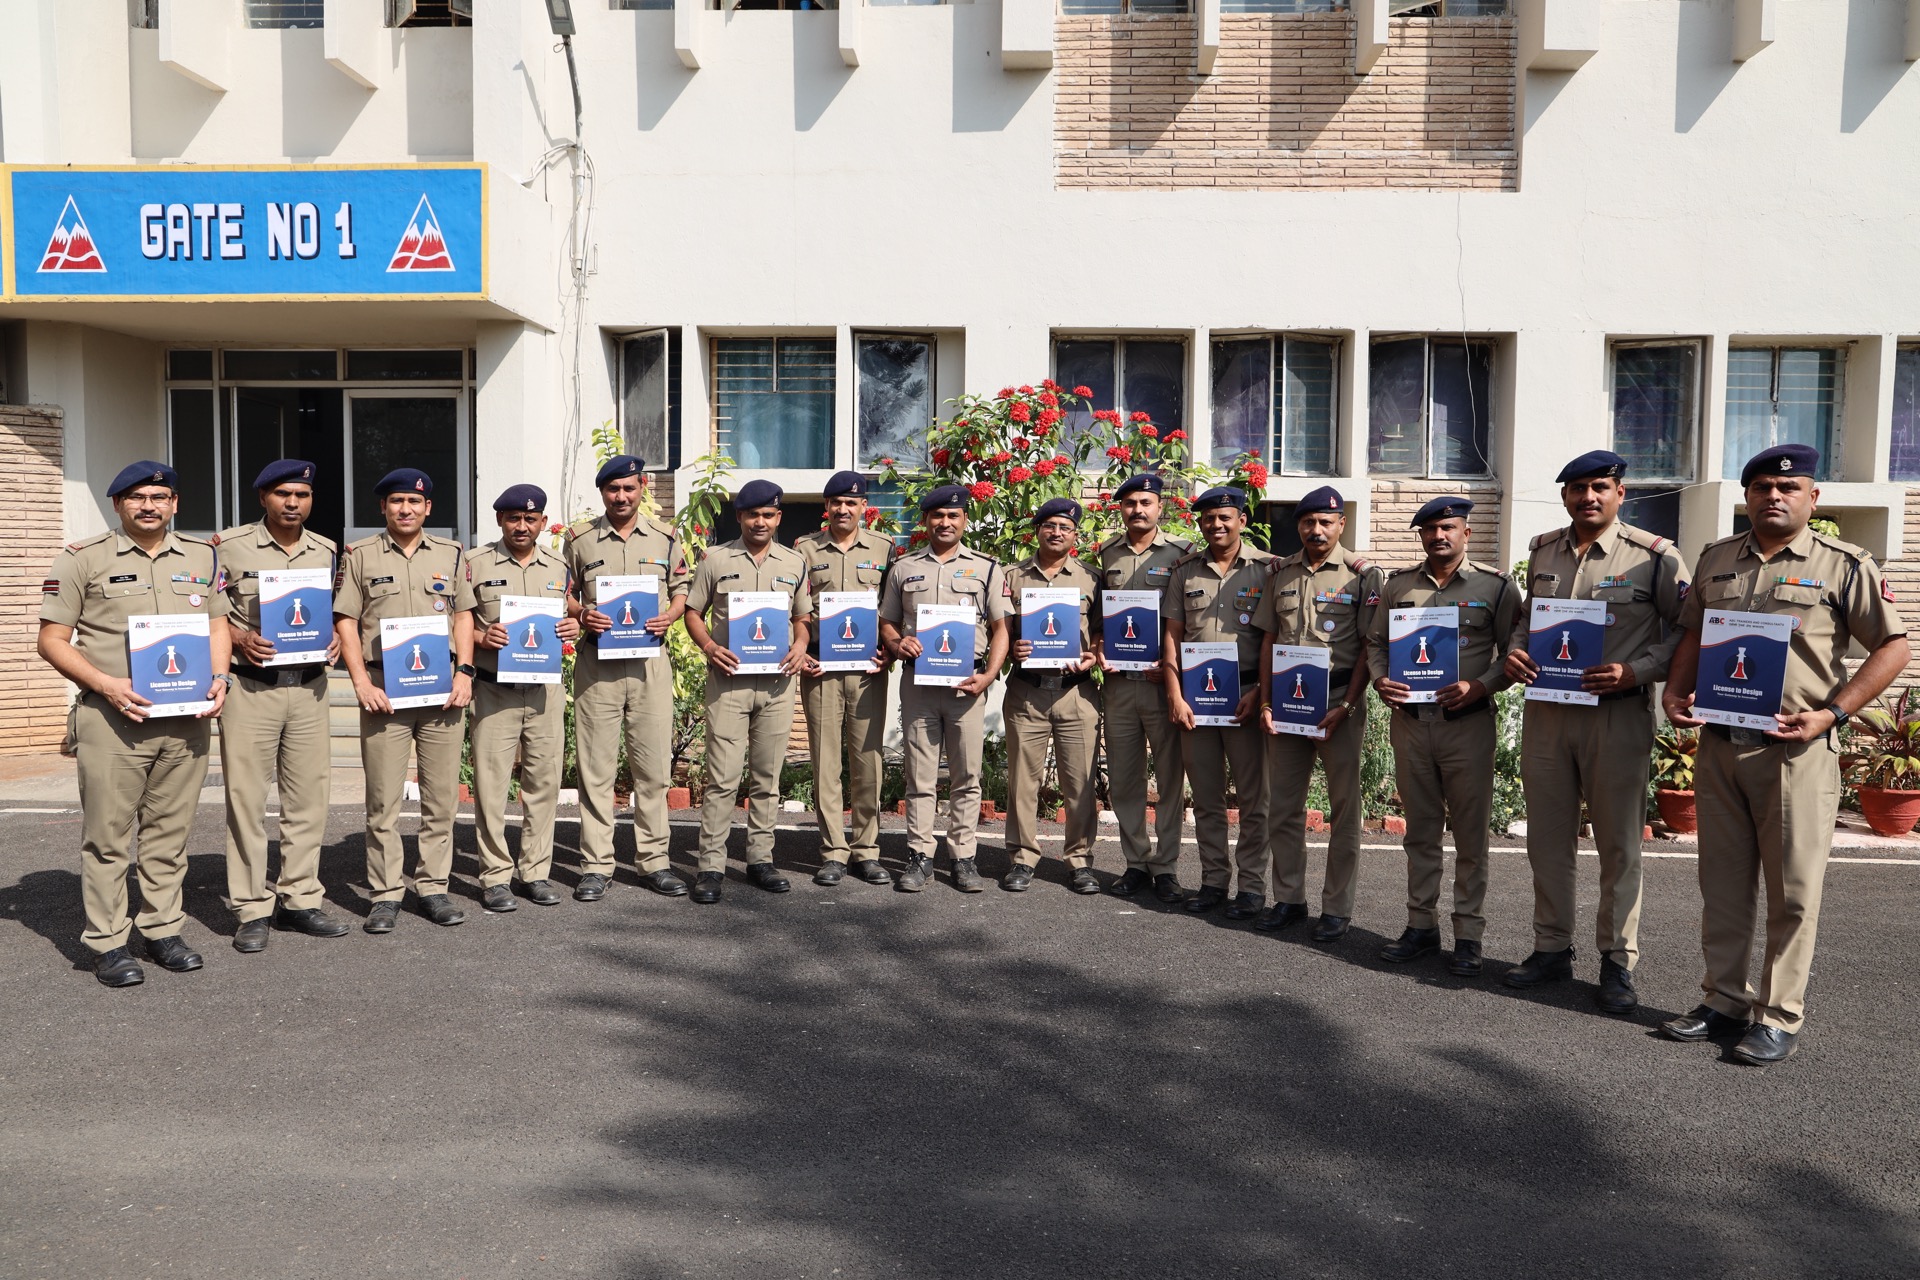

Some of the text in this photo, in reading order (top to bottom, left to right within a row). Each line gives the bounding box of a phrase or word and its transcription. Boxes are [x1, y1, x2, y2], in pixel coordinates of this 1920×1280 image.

[140, 202, 357, 261] GATE NO 1
[1713, 684, 1734, 693] License
[1743, 688, 1763, 696] Design
